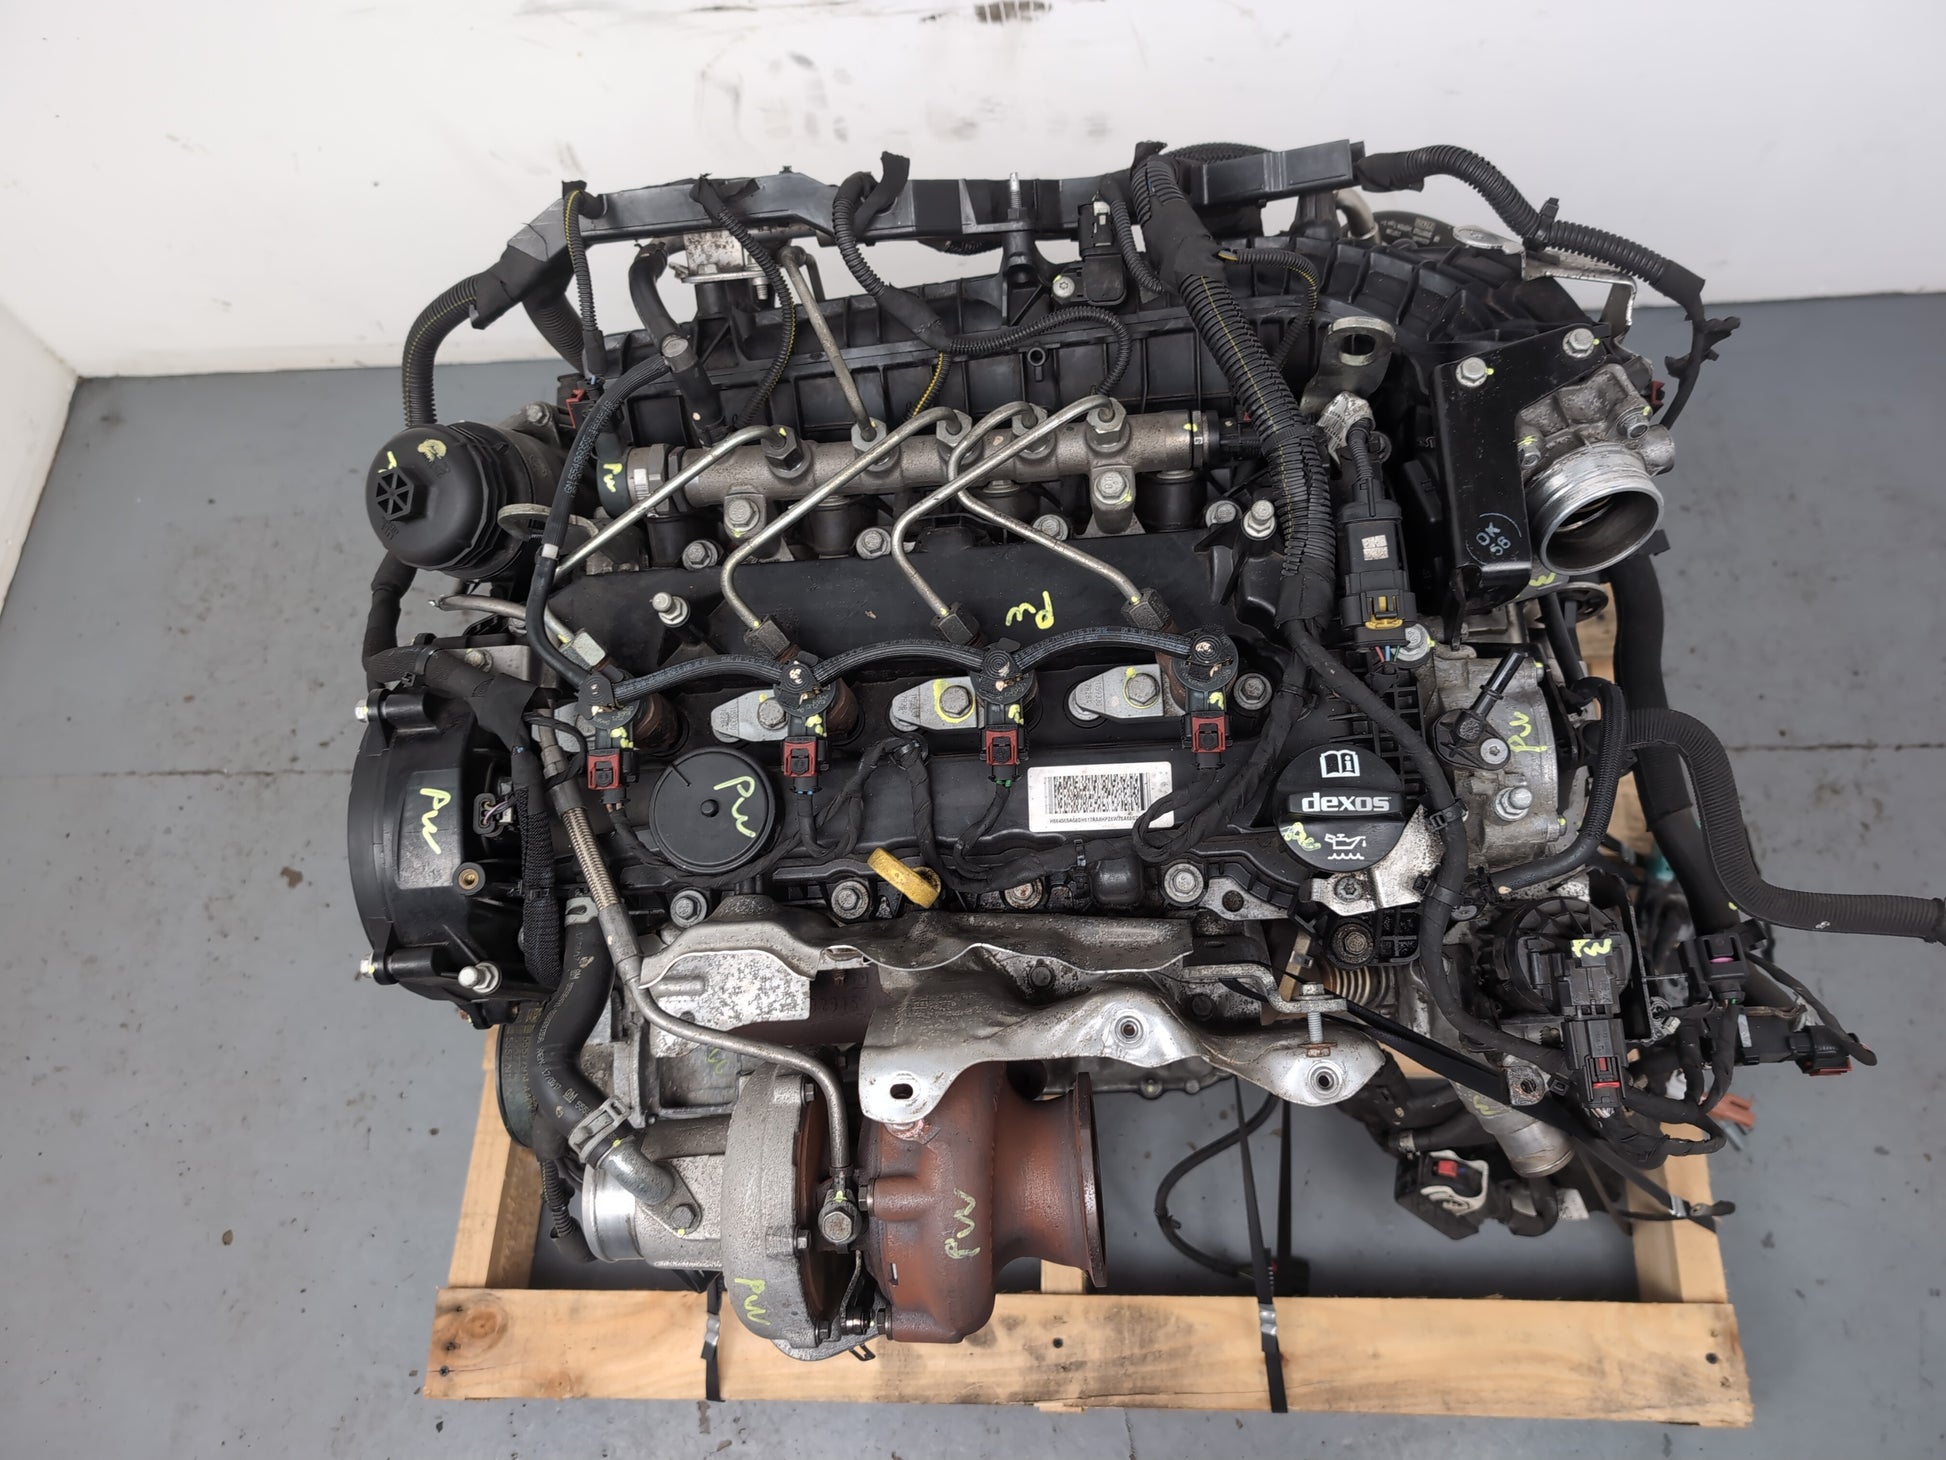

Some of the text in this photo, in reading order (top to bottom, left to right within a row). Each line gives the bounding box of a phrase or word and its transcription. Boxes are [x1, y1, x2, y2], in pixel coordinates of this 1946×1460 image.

[1475, 521, 1502, 546] OK
[1489, 535, 1512, 556] 56
[1301, 791, 1391, 812] dexos
